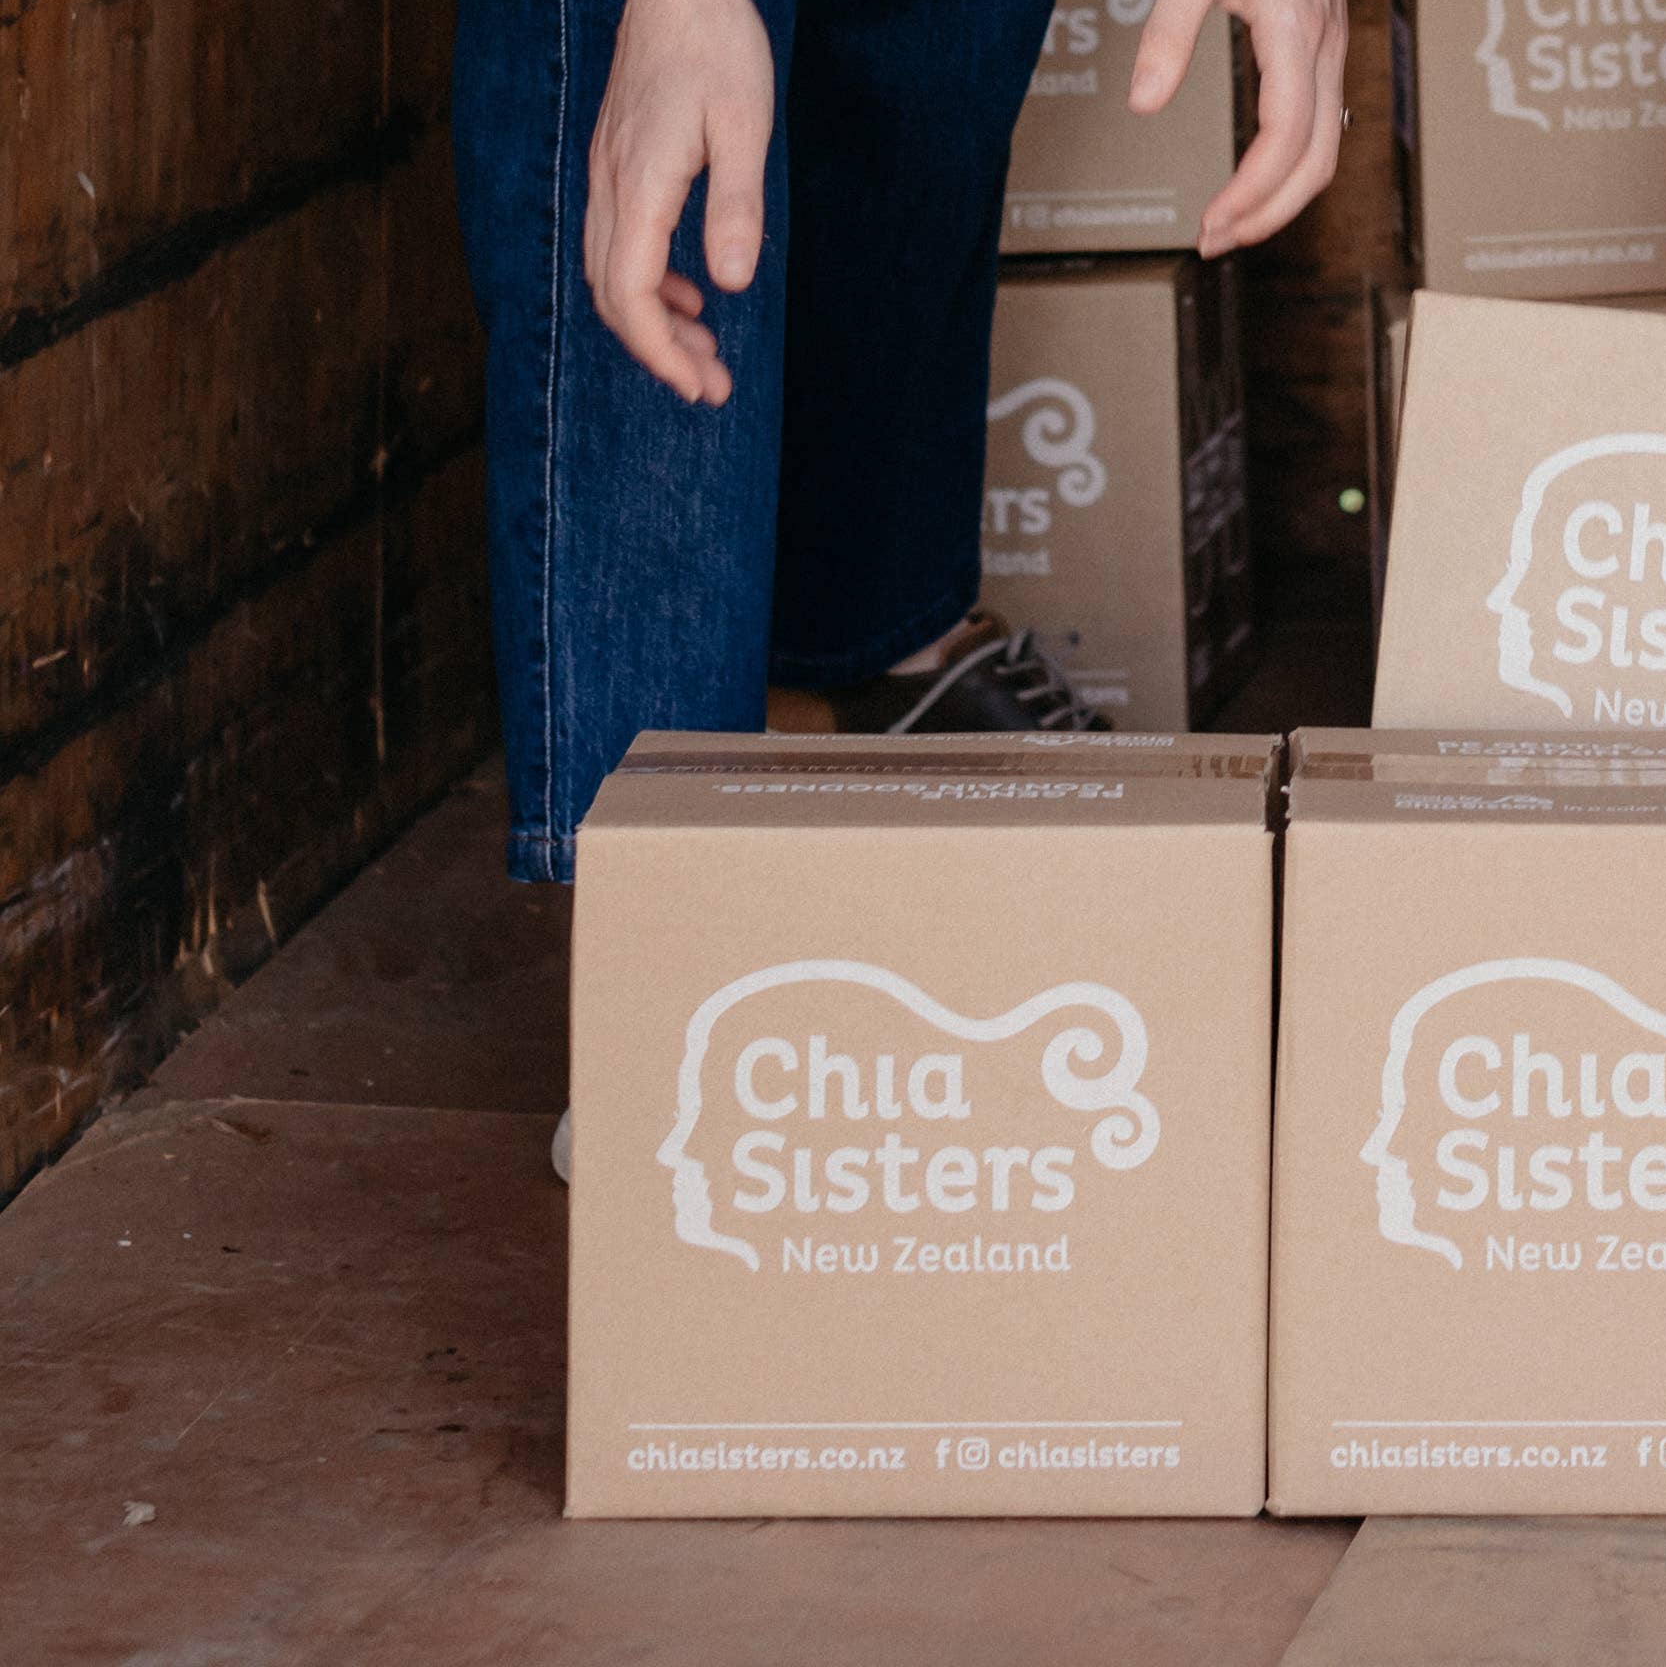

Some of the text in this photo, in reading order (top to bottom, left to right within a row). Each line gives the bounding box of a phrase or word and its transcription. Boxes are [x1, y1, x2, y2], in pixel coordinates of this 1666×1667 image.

[1563, 107, 1630, 129] New
[735, 1034, 972, 1120] Chia
[733, 1131, 1075, 1213] Sisters
[783, 1235, 1071, 1273] New Zealand
[1486, 1235, 1582, 1271] New
[627, 1441, 905, 1470] chiasisters.co.nz
[998, 1440, 1180, 1468] chiasisters
[1330, 1439, 1607, 1468] chiasisters.co.nz
